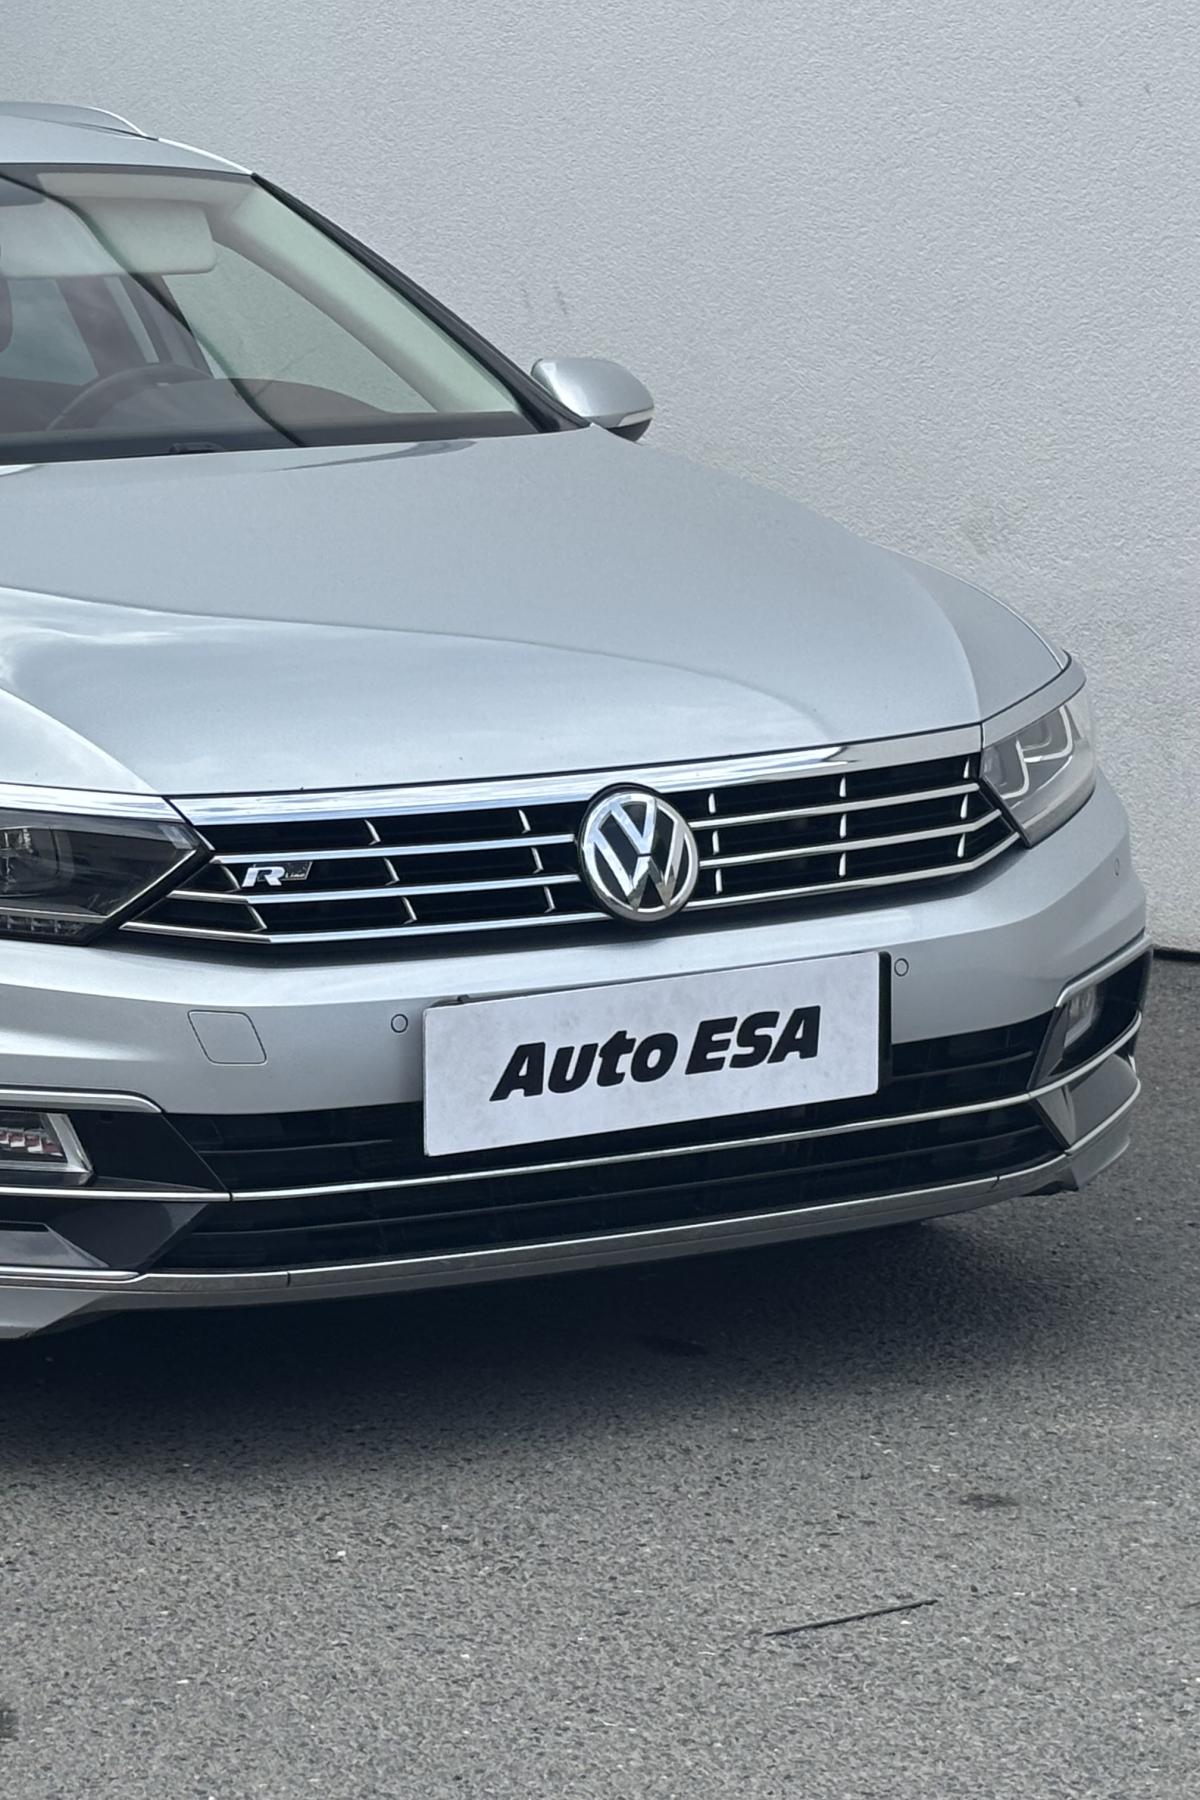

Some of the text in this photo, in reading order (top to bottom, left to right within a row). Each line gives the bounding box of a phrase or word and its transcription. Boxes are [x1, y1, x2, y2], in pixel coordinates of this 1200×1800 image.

[587, 794, 691, 913] VW
[489, 1005, 821, 1101] Auto ESA
